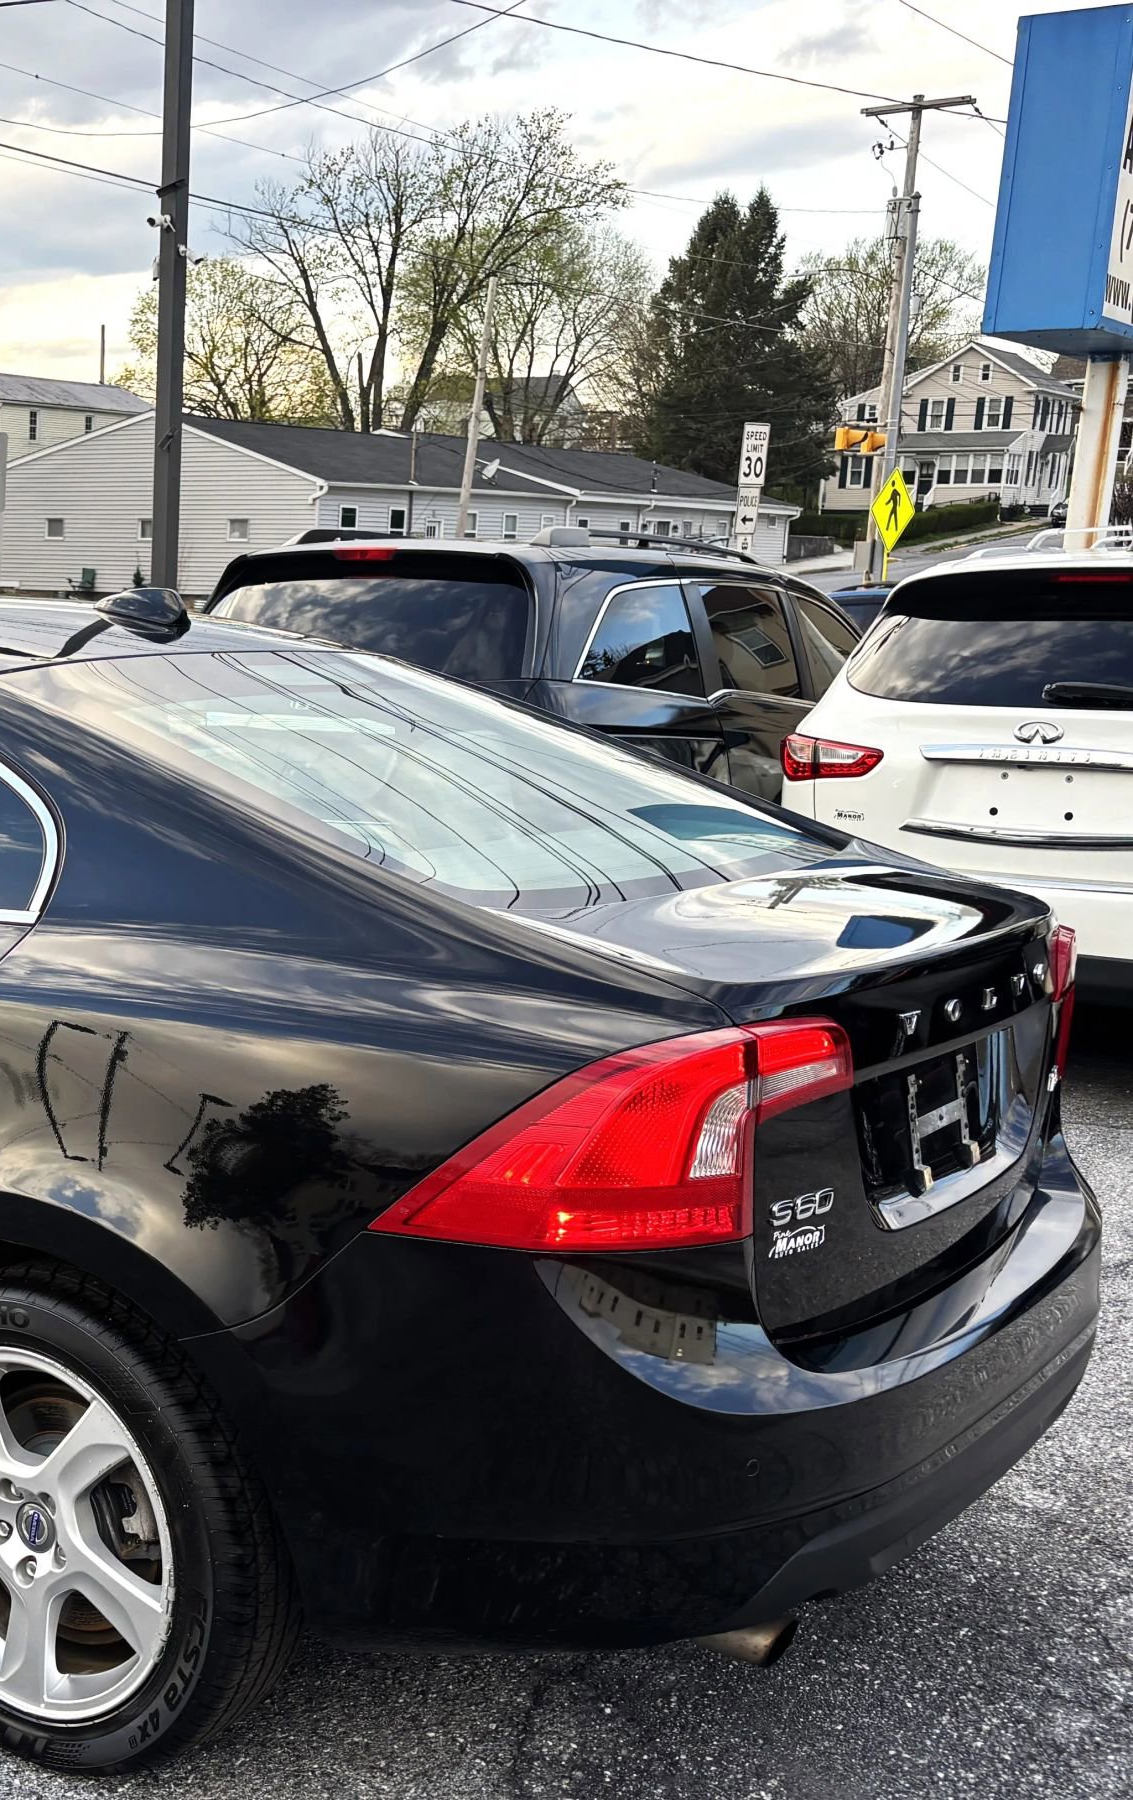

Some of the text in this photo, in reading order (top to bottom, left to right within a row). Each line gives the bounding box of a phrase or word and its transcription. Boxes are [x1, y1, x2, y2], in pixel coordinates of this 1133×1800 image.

[746, 431, 767, 441] SPEED
[746, 443, 764, 454] LIMIT
[743, 456, 764, 478] 30
[739, 495, 759, 508] POLICE
[897, 963, 1045, 1036] VOLVO
[770, 1187, 834, 1227] S60
[775, 1231, 820, 1254] MANOR
